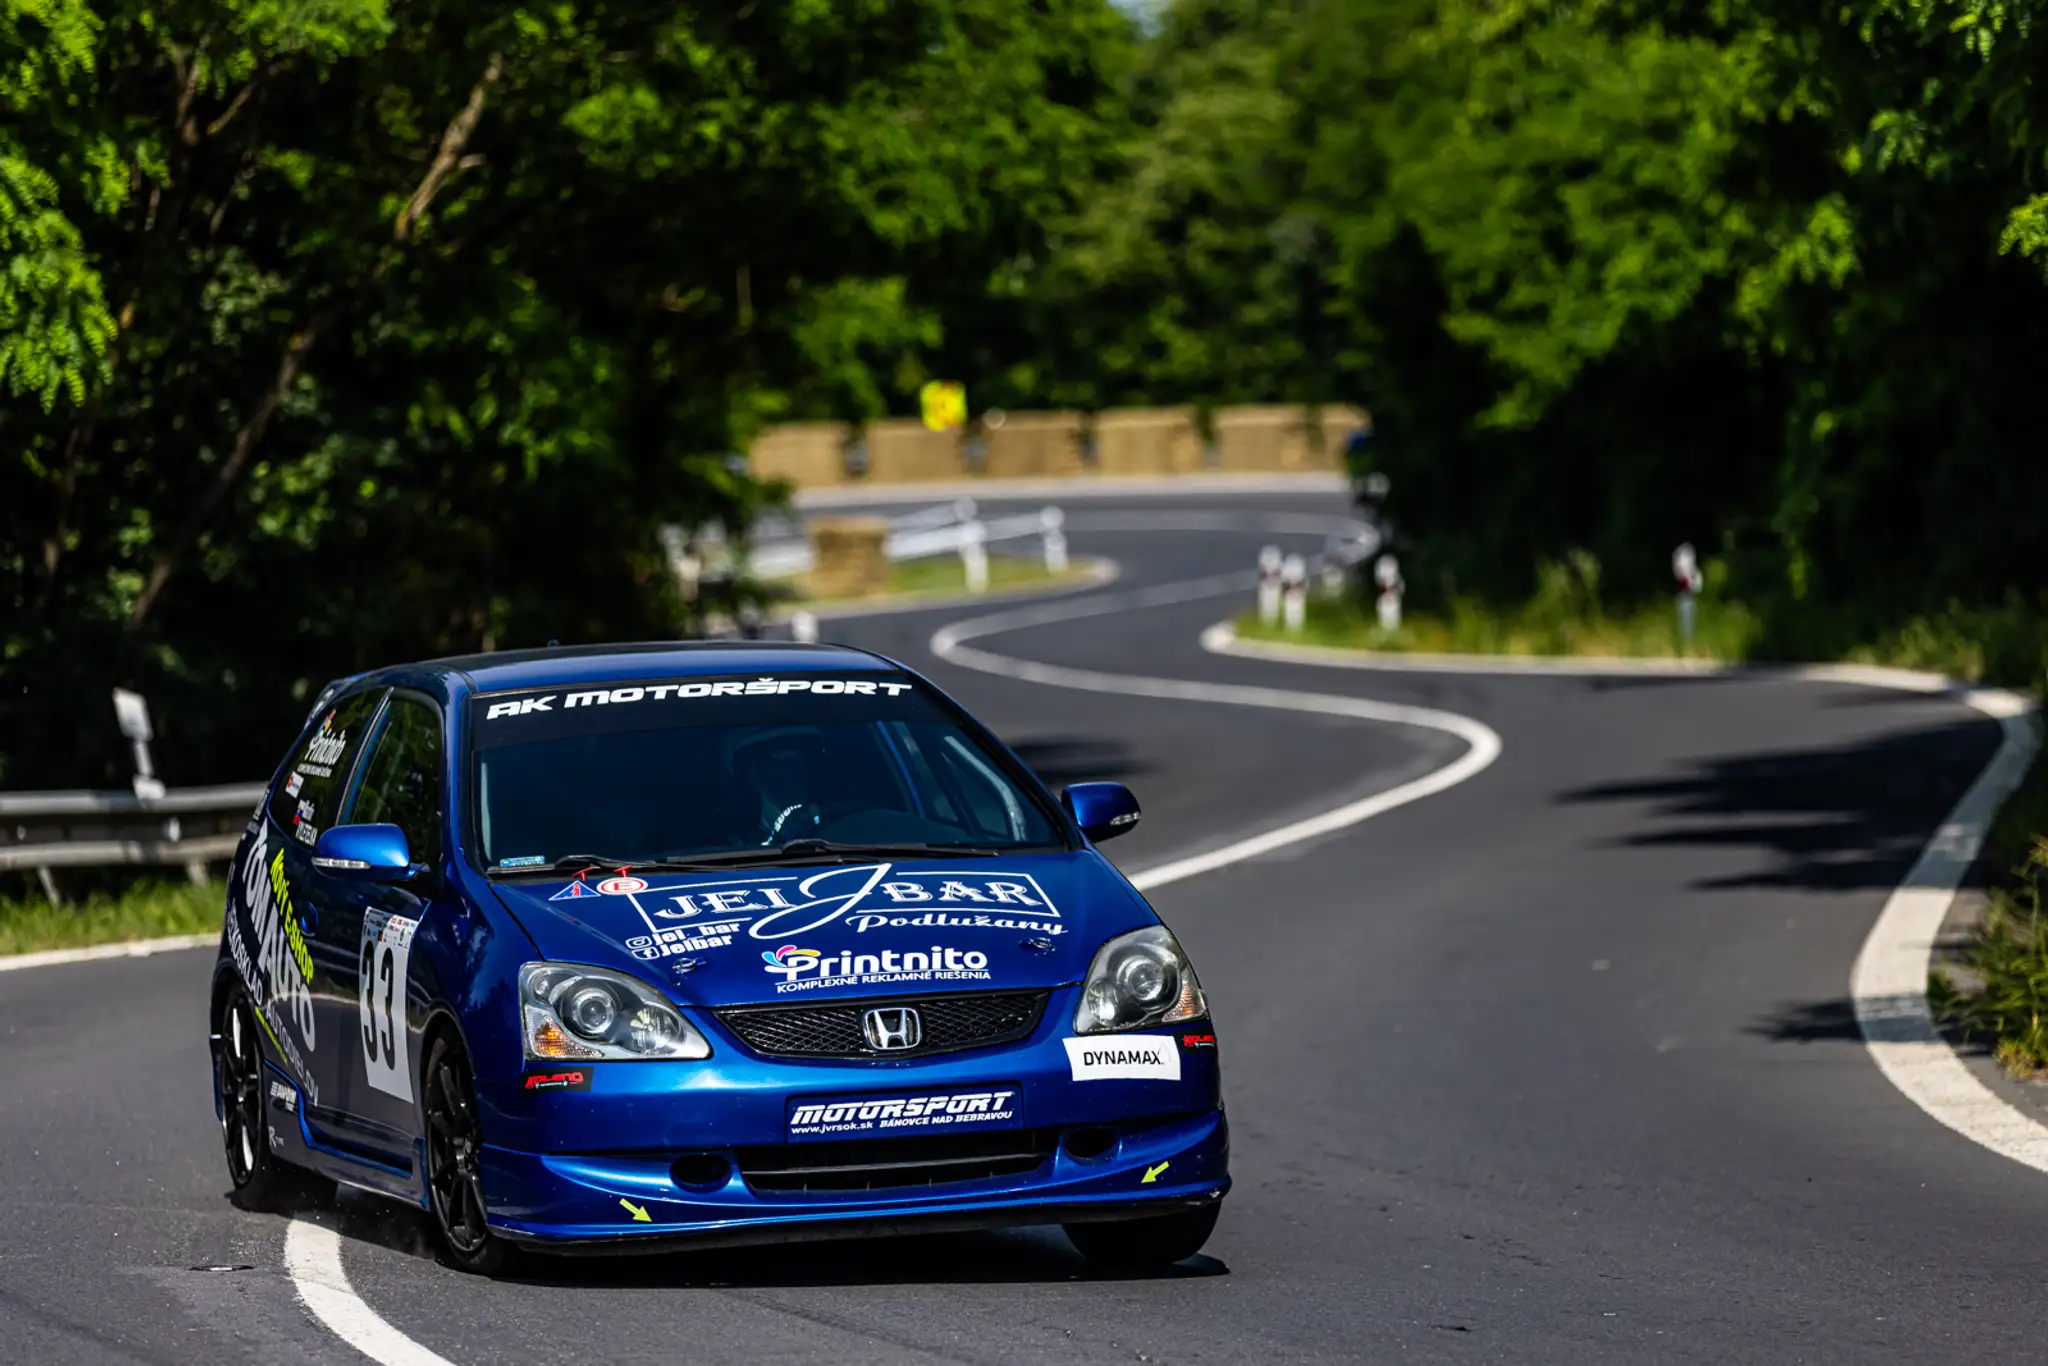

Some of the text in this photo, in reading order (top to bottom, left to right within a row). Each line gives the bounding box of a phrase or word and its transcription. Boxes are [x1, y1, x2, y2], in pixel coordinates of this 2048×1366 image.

[486, 677, 913, 720] AK MOTORŠPORT
[880, 881, 1044, 906] BAR
[845, 913, 1068, 935] Podlužany
[765, 945, 988, 981] Printnito
[777, 974, 858, 994] KOMPLEXNÉ
[862, 970, 932, 984] REKLAMNÉ
[361, 939, 396, 1072] 33
[1083, 1050, 1161, 1066] DYNAMAX
[790, 1091, 1014, 1125] MOTORSPORT
[791, 1111, 1013, 1134] www.jvrsok.sk BÁNOVCE NAD BEBRAVOU
